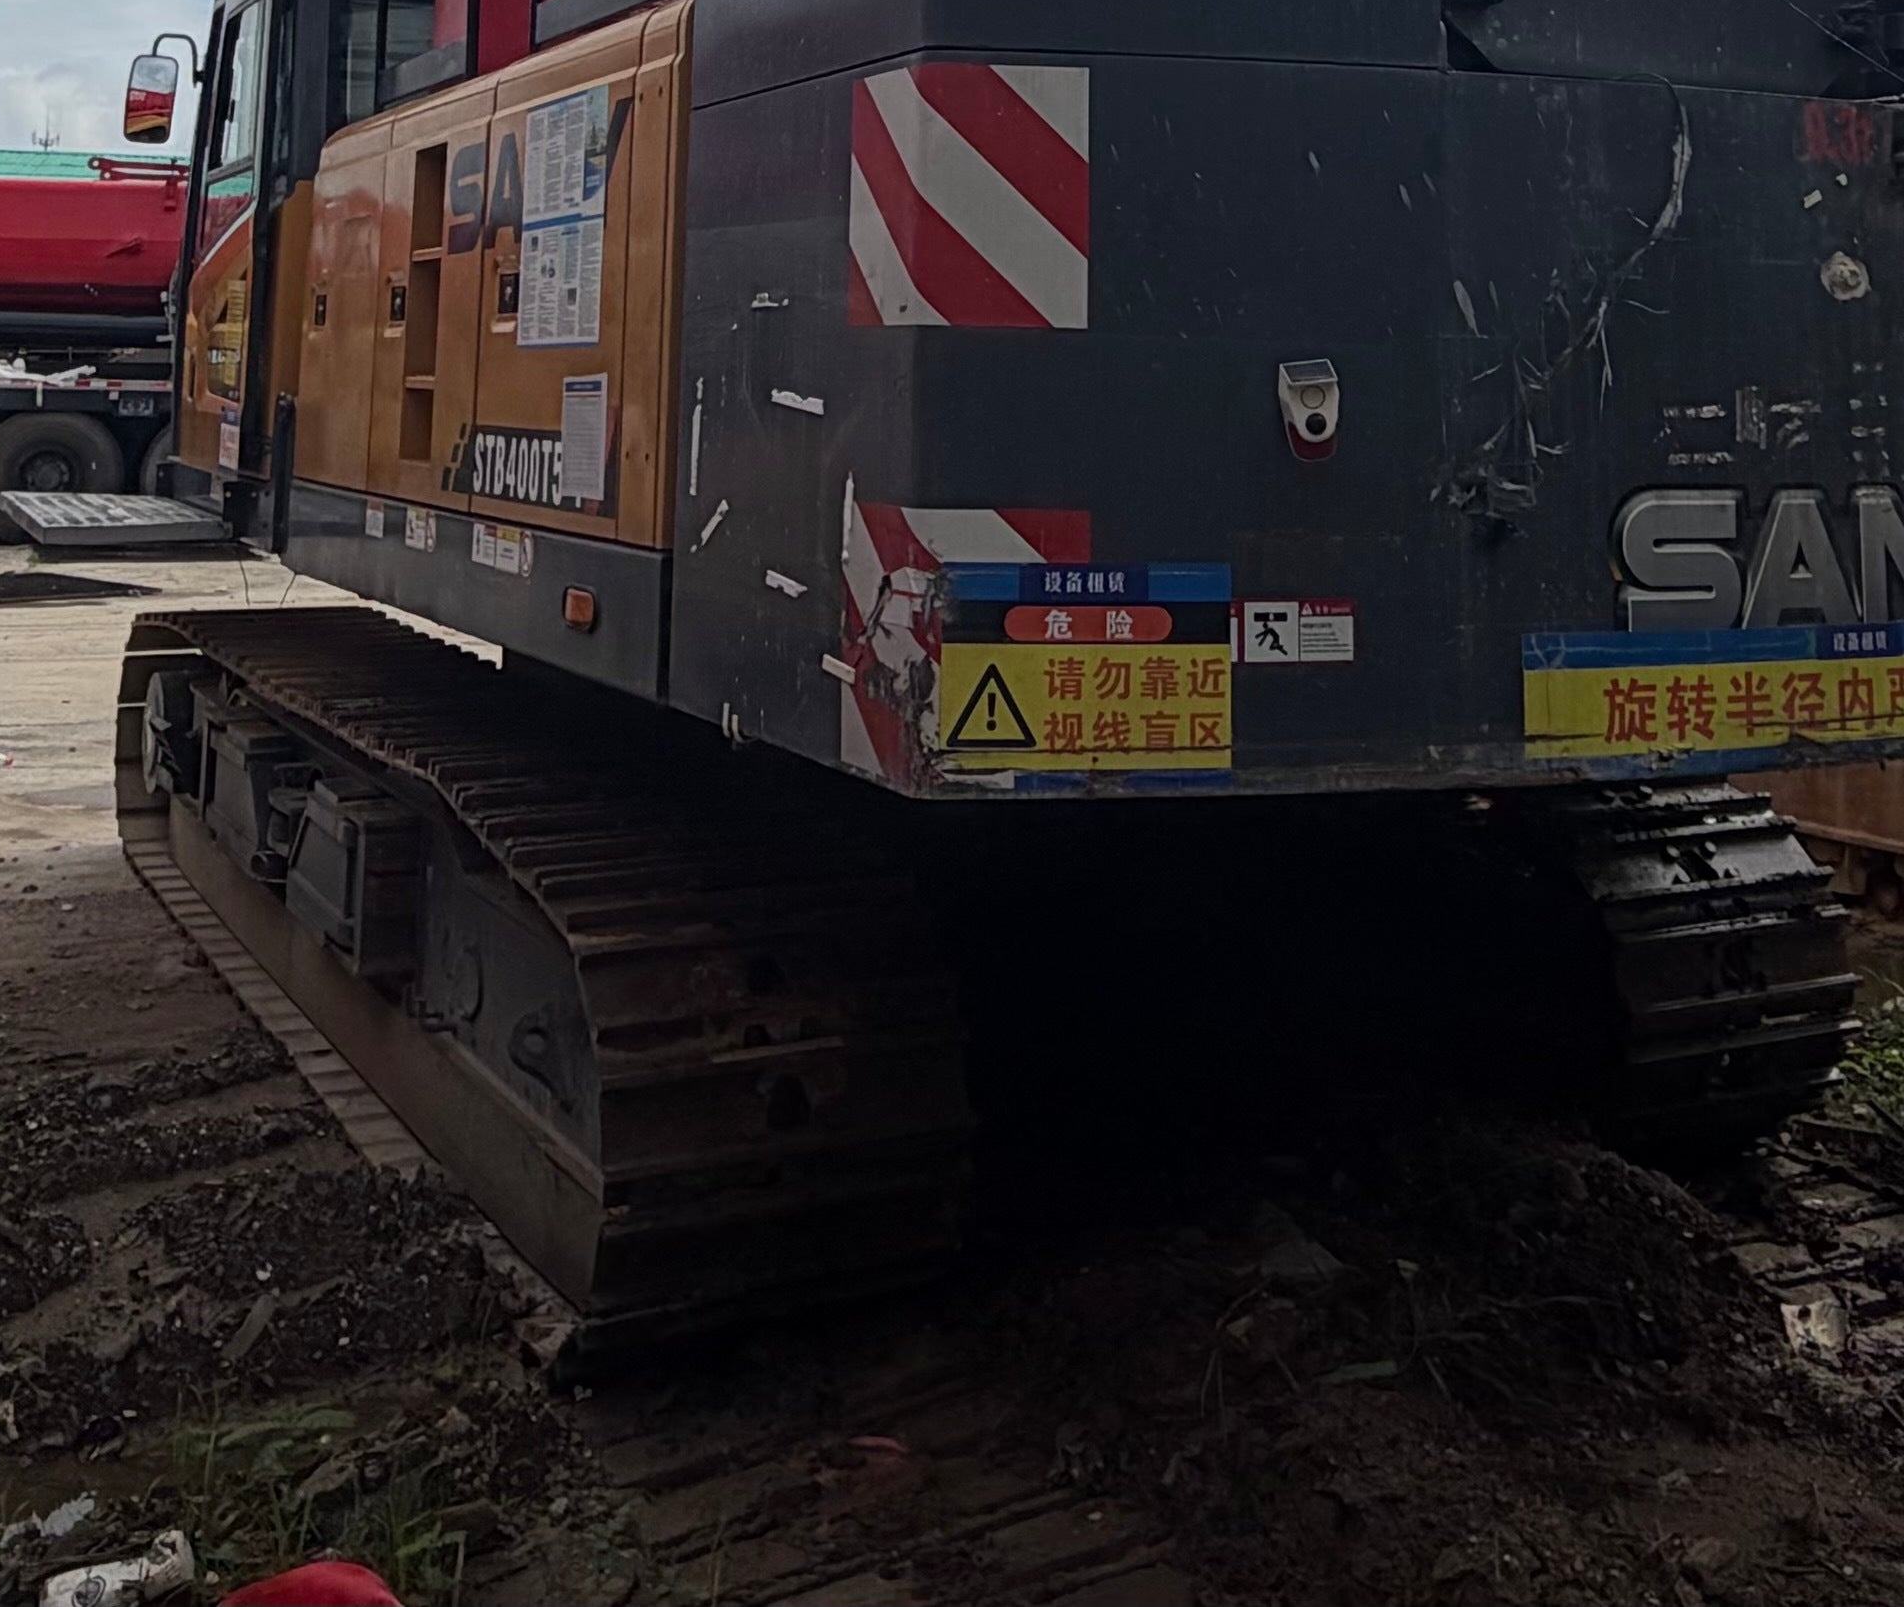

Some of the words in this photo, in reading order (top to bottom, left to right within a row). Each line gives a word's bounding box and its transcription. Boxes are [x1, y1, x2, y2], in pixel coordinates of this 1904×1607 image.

[1044, 571, 1126, 594] 设备租赁
[1044, 609, 1135, 640] 危险
[1043, 655, 1227, 701] 请勿靠近
[1043, 710, 1225, 755] 视线盲区
